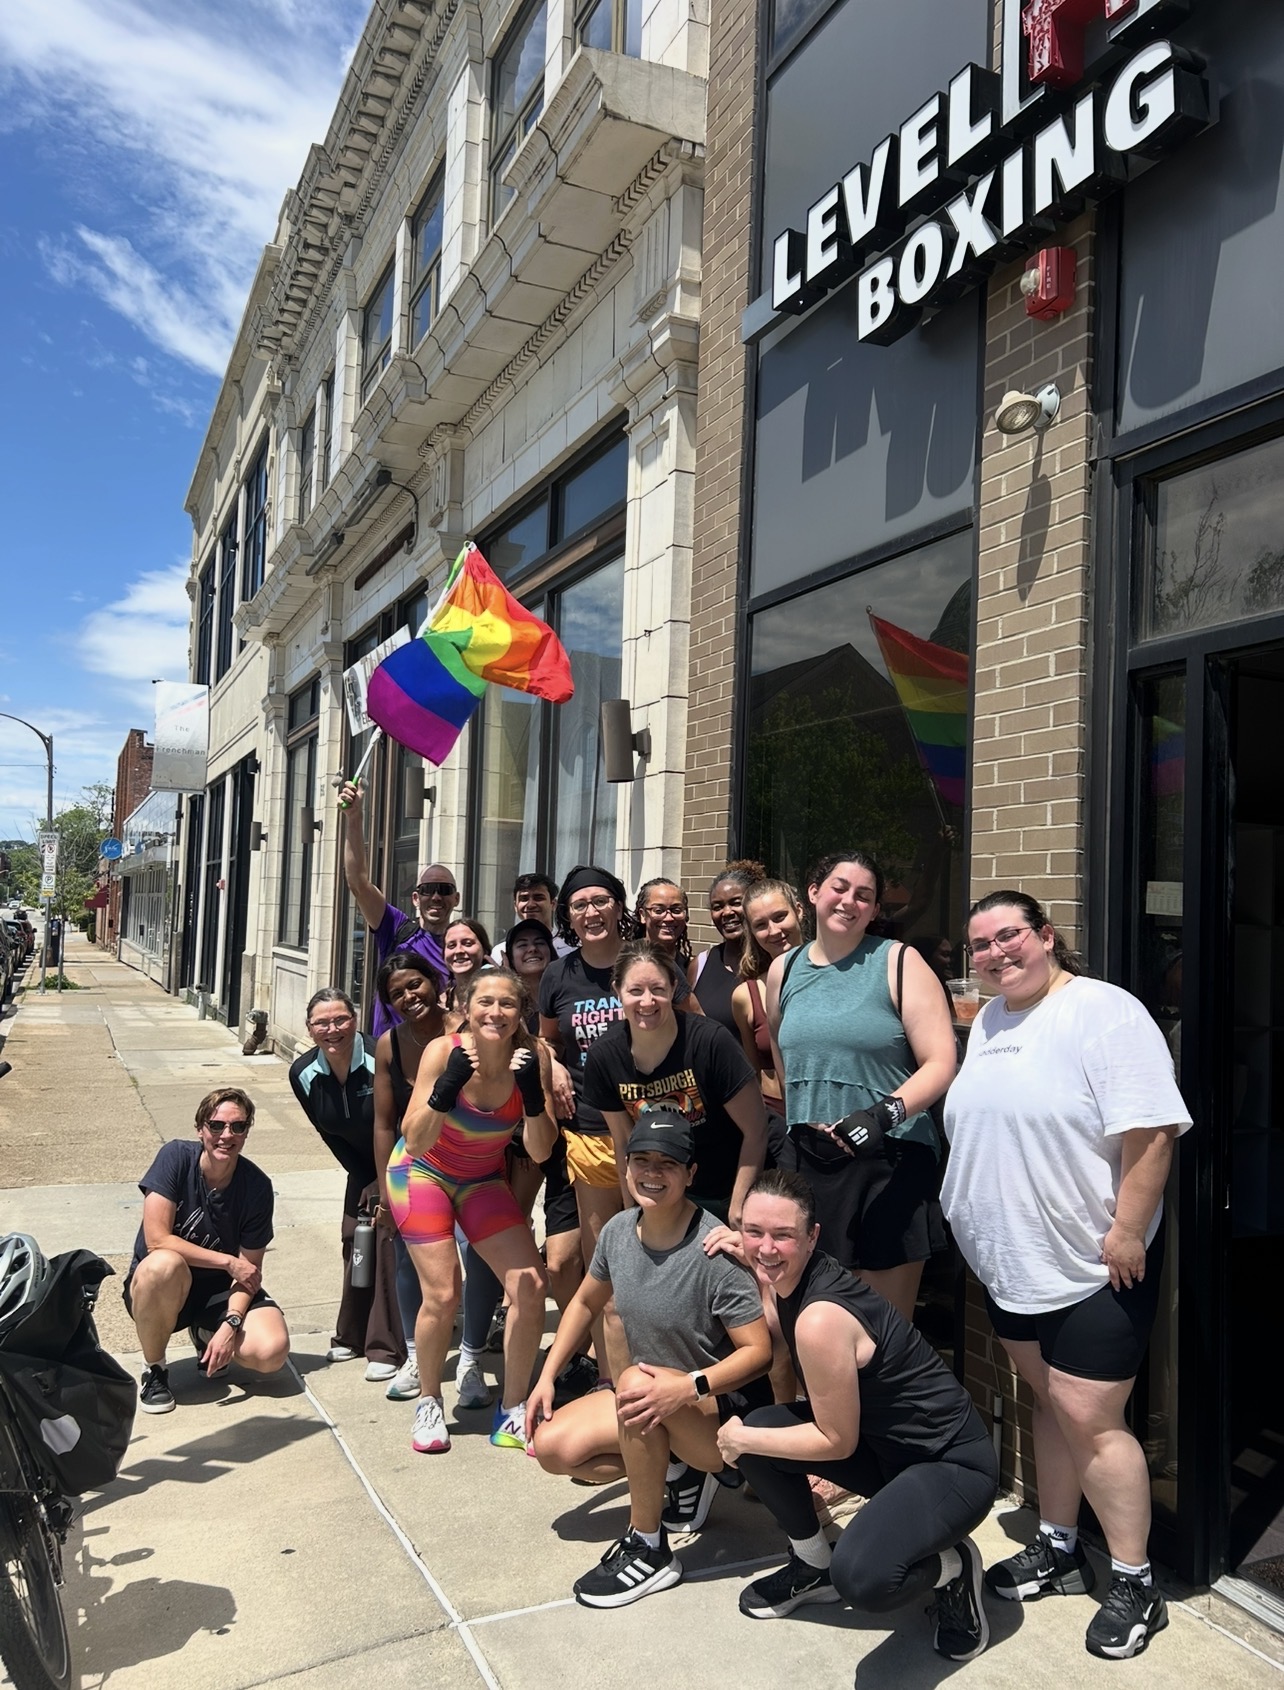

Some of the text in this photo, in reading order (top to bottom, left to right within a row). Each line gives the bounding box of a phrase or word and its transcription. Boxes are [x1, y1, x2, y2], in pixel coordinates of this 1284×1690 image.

[772, 62, 994, 311] LEVEL
[857, 39, 1178, 343] BOXING
[174, 724, 191, 733] The
[574, 996, 623, 1013] TRAN
[571, 1007, 624, 1027] RIGHT
[575, 1022, 608, 1040] ARE
[619, 1068, 697, 1100] PITTSBURGH
